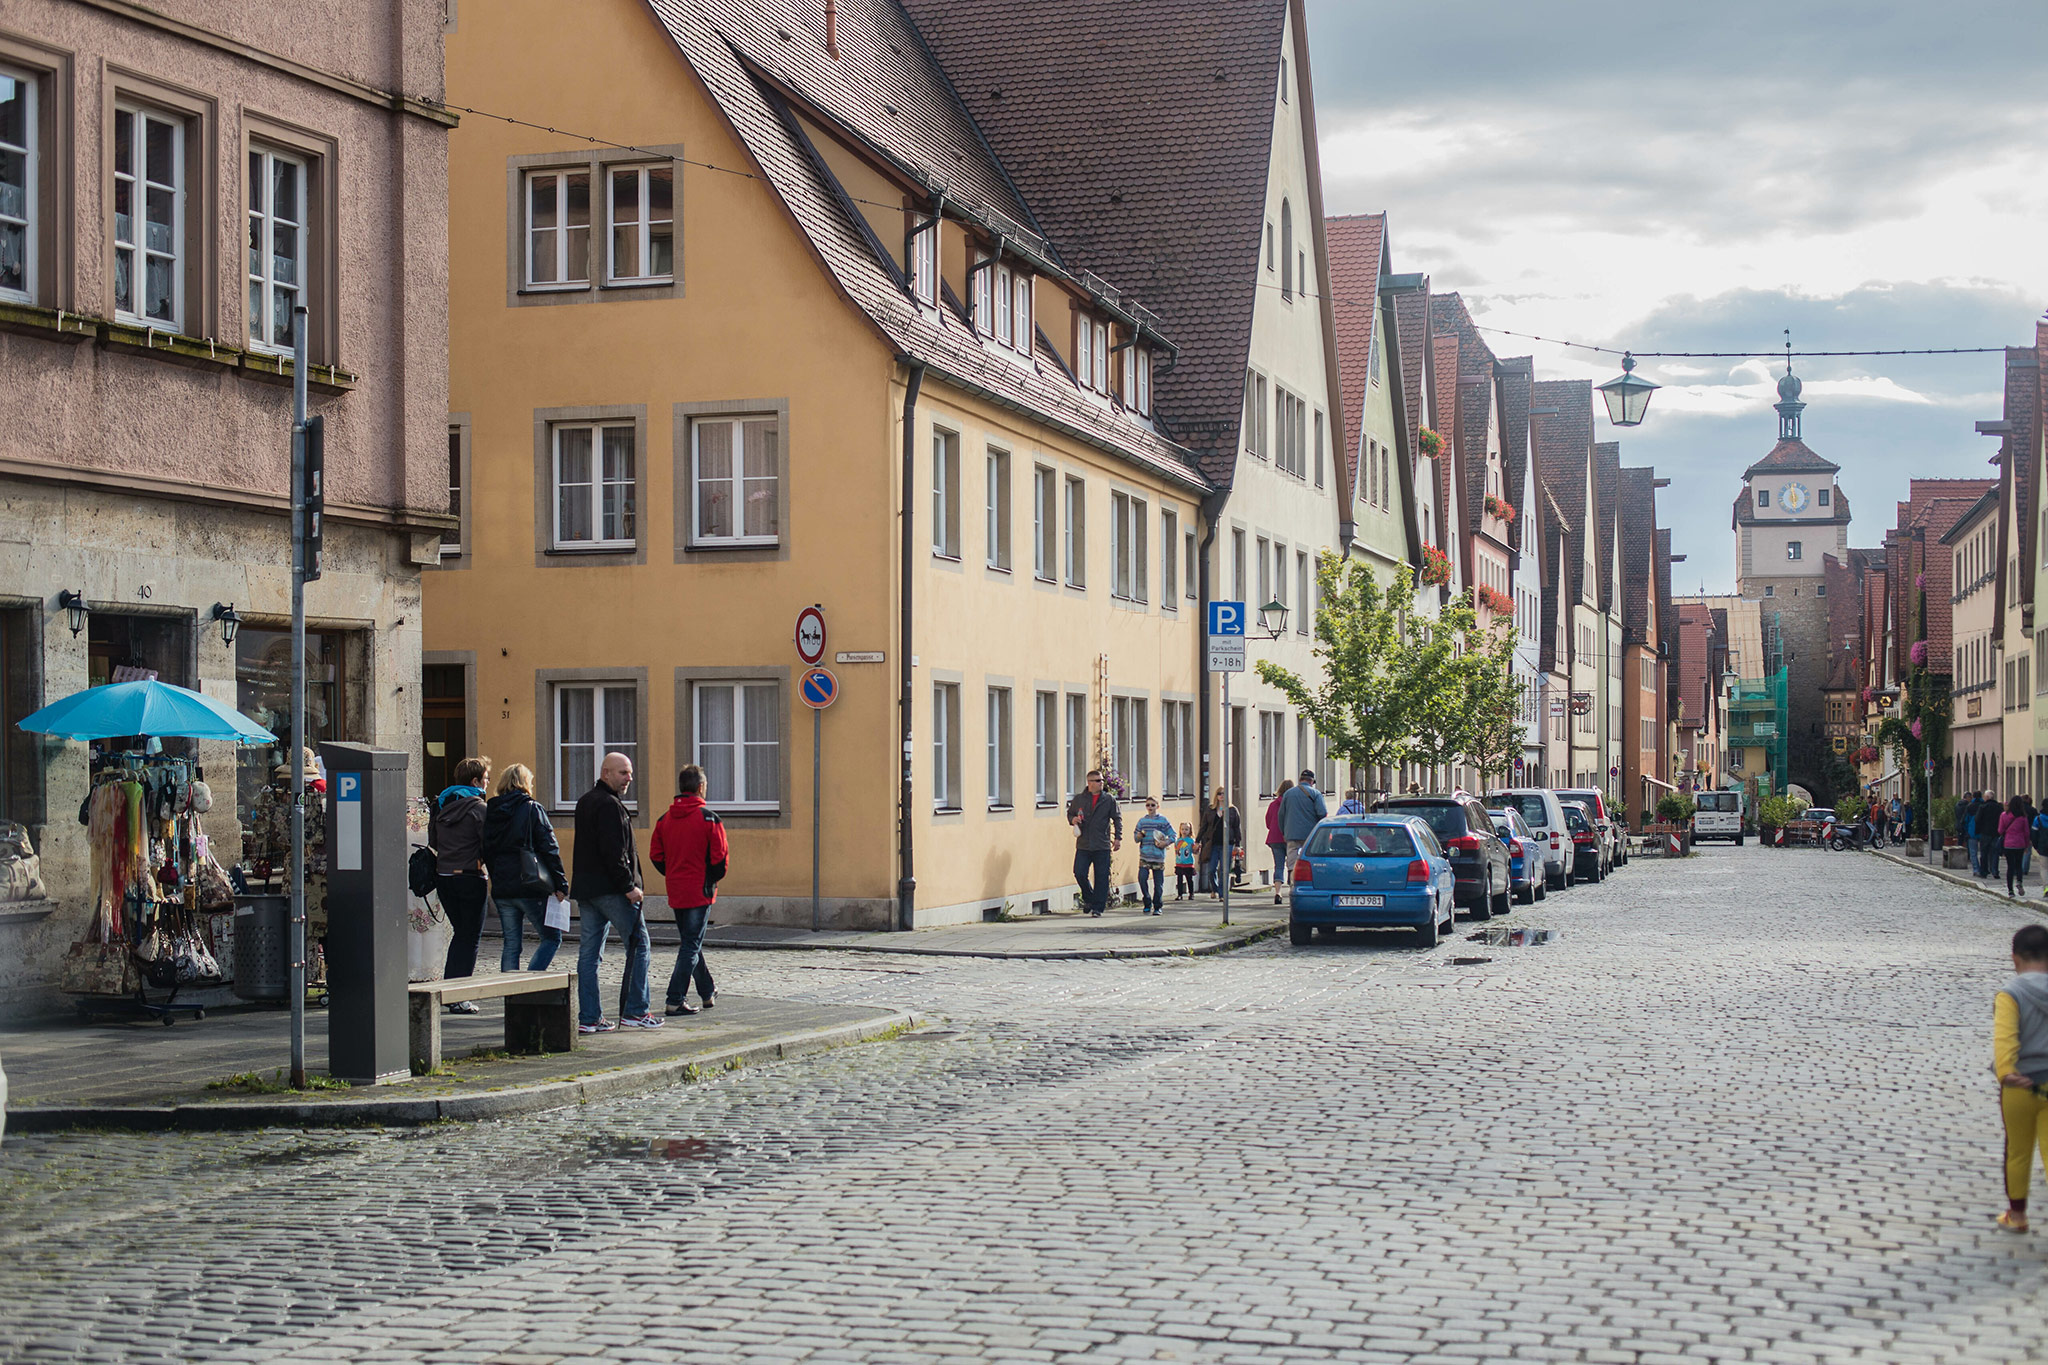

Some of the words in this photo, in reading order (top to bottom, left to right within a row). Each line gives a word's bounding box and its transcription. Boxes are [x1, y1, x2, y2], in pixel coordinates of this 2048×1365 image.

[136, 585, 152, 599] 40
[1217, 605, 1237, 633] P
[501, 710, 510, 719] 31
[340, 777, 357, 797] P
